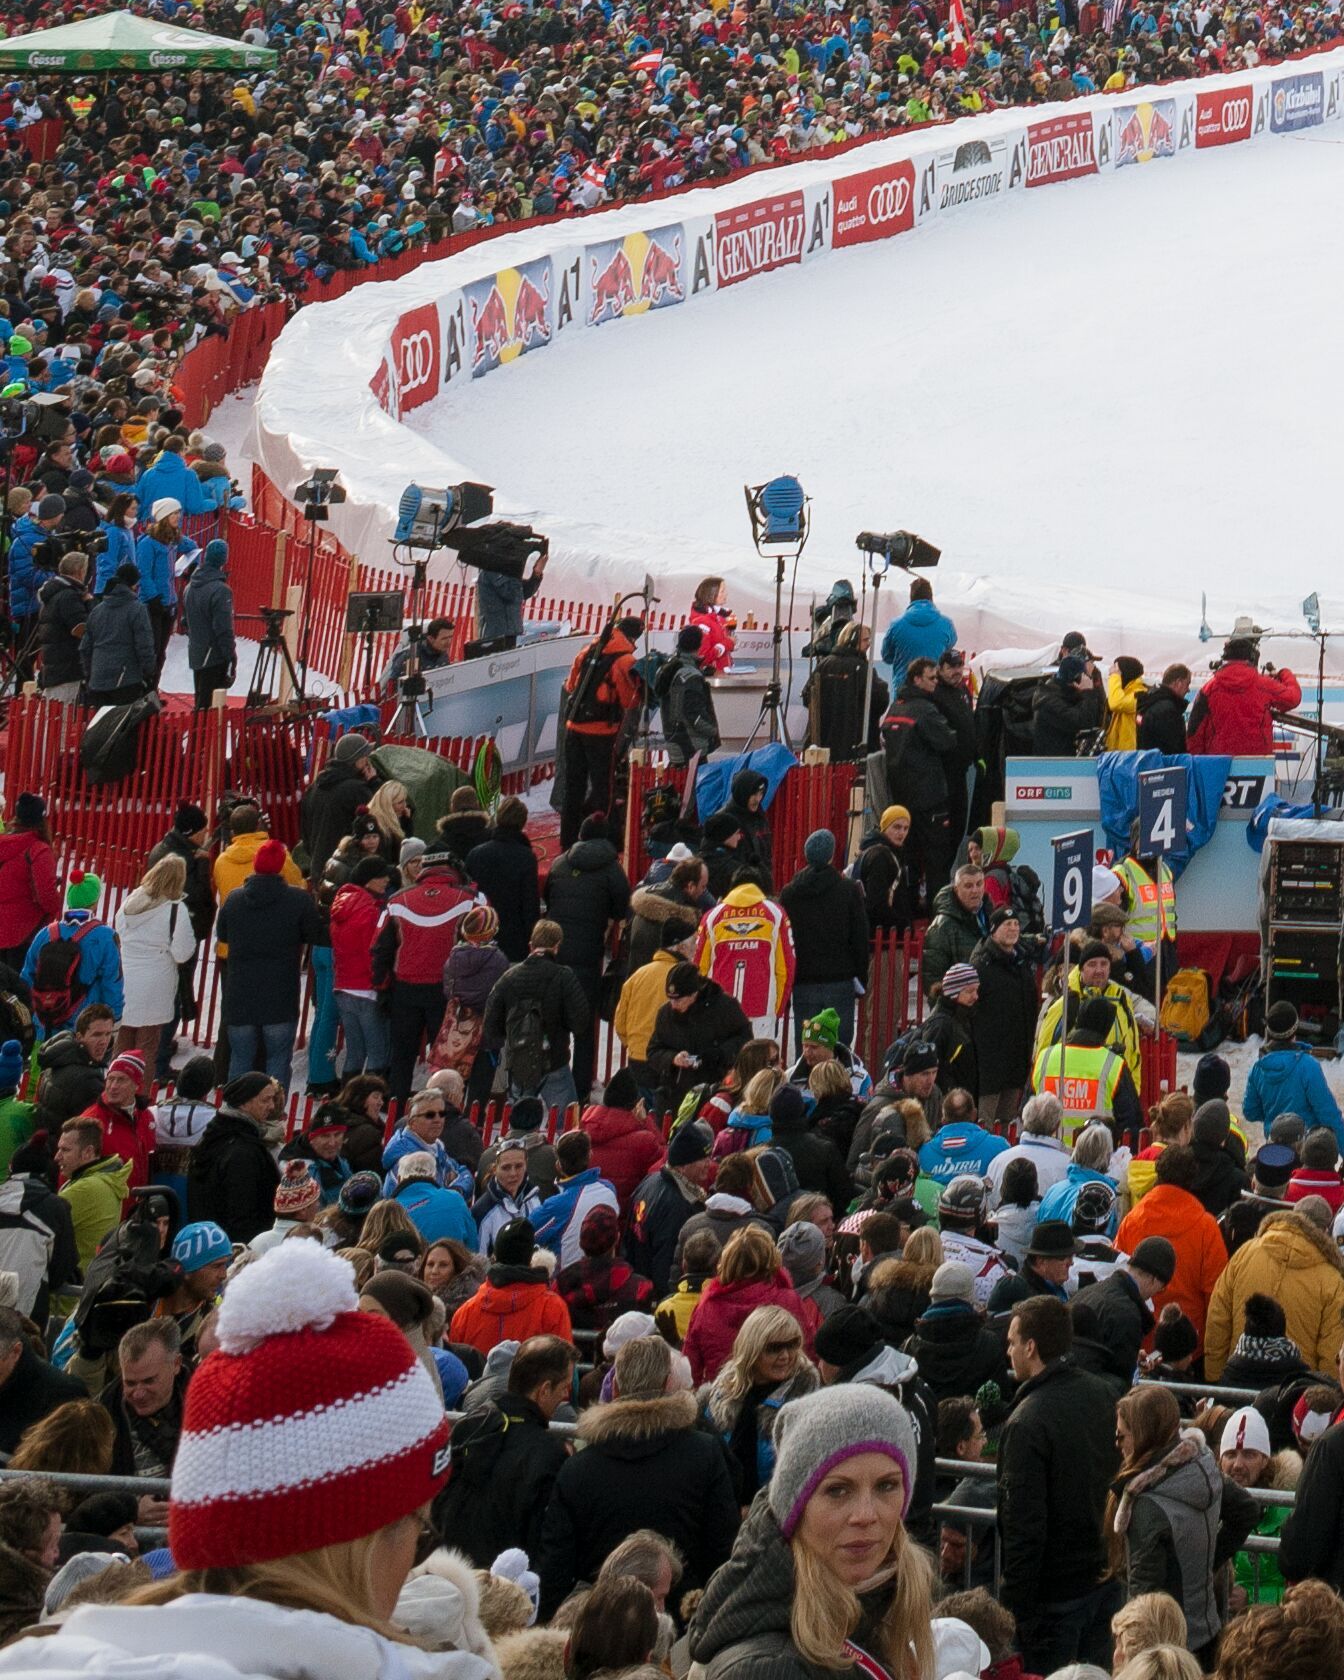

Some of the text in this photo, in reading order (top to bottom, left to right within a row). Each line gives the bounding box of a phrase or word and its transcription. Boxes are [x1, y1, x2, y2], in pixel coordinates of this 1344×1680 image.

[28, 51, 66, 66] Gösser
[149, 51, 187, 67] Gösser
[1285, 85, 1321, 110] Kitzbühel
[1199, 108, 1212, 121] Audi
[1028, 130, 1094, 181] GENERALI
[939, 171, 1003, 210] BRIDGESTONE
[837, 195, 857, 213] Audi
[837, 215, 865, 233] quattro
[719, 214, 805, 281] GENERALI
[1017, 786, 1071, 799] ORF eins
[1150, 798, 1176, 849] 4
[1067, 854, 1081, 865] TEAM
[1063, 866, 1084, 925] 9
[724, 908, 766, 919] RACING
[728, 940, 759, 951] TEAM
